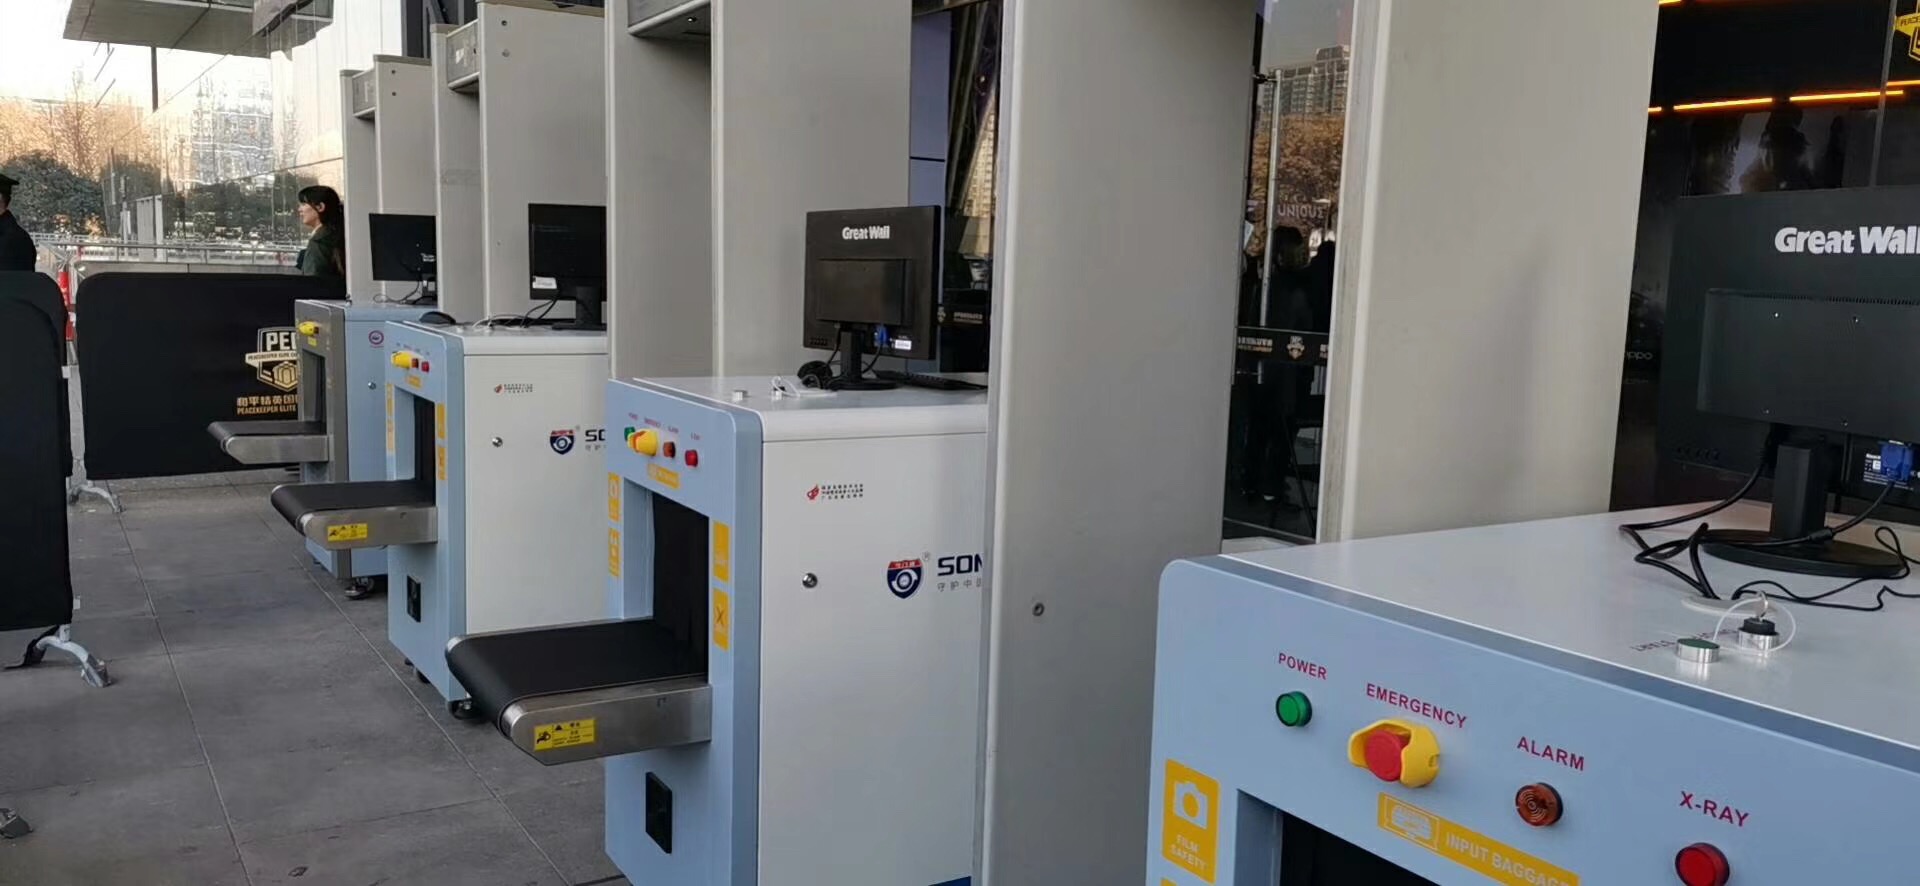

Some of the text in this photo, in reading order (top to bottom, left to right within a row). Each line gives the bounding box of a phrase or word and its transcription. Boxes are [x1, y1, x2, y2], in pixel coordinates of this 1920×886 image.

[842, 225, 890, 240] Great Wall
[1774, 226, 1855, 255] Great
[1278, 652, 1328, 681] POWER
[1366, 682, 1467, 729] EMERGENCY
[1516, 735, 1586, 773] ALARM
[1679, 790, 1750, 828] X-RAY
[1445, 830, 1490, 863] INPUT
